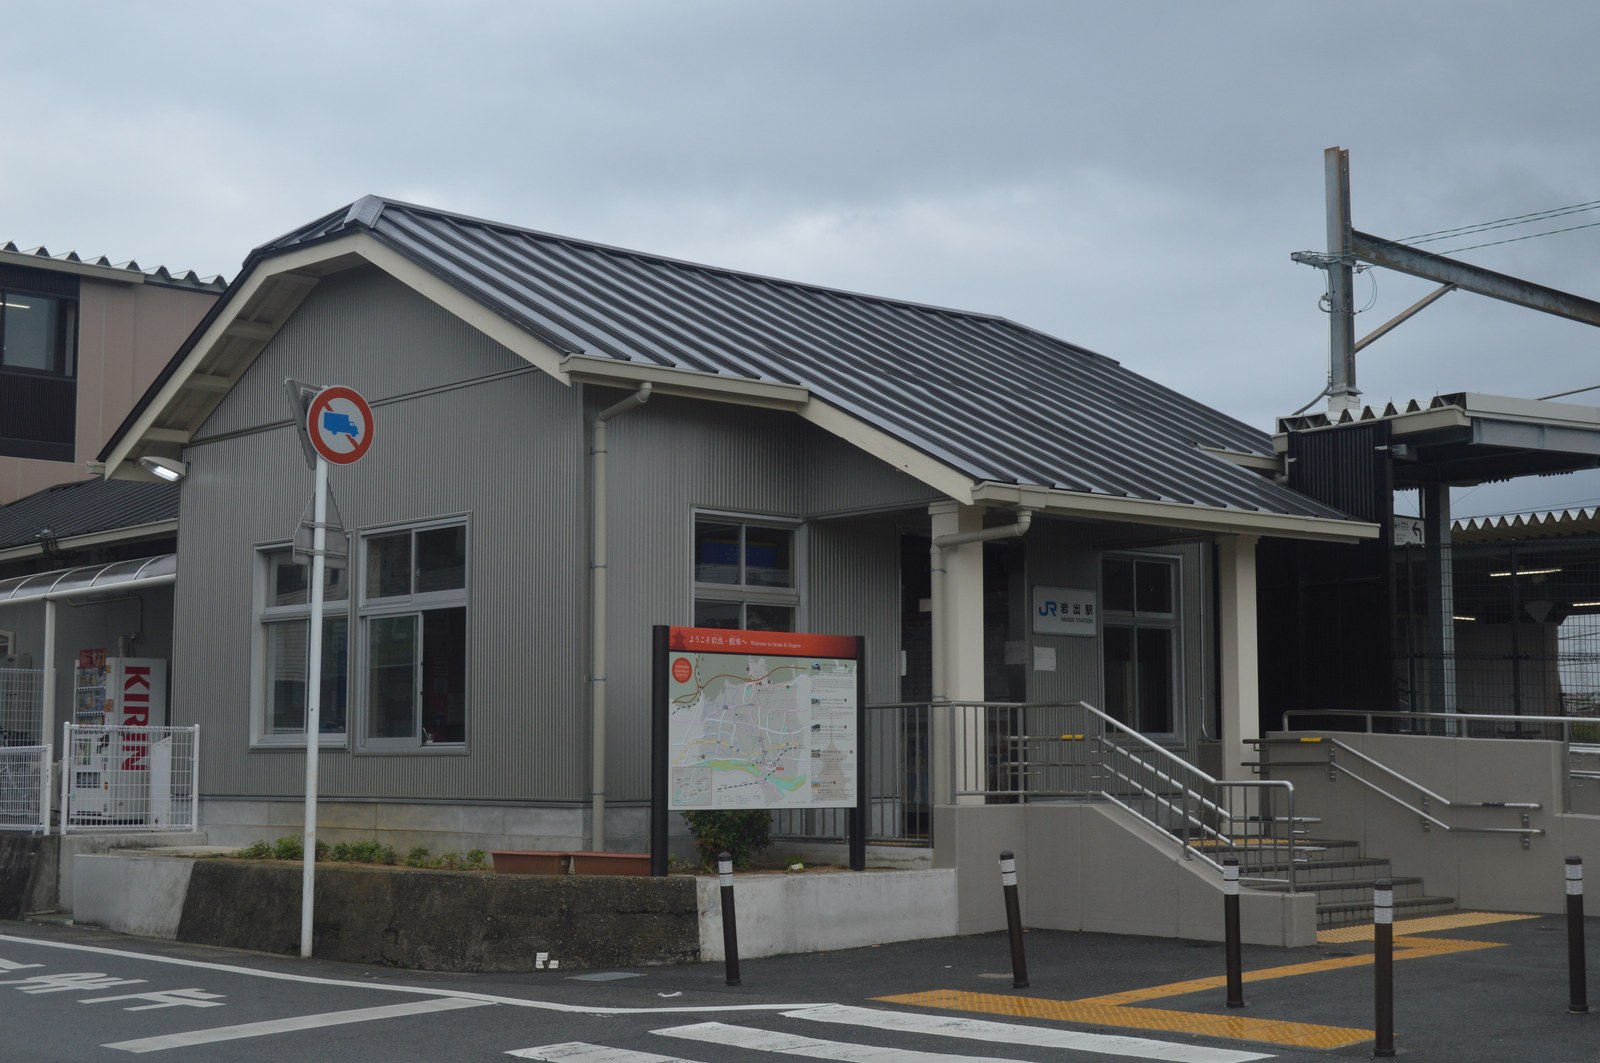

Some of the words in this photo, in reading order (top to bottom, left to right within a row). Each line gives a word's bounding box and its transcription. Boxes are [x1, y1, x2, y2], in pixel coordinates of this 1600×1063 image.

[1038, 601, 1057, 617] JR
[1060, 602, 1093, 615] 岩出駅
[122, 666, 150, 770] KIRIN
